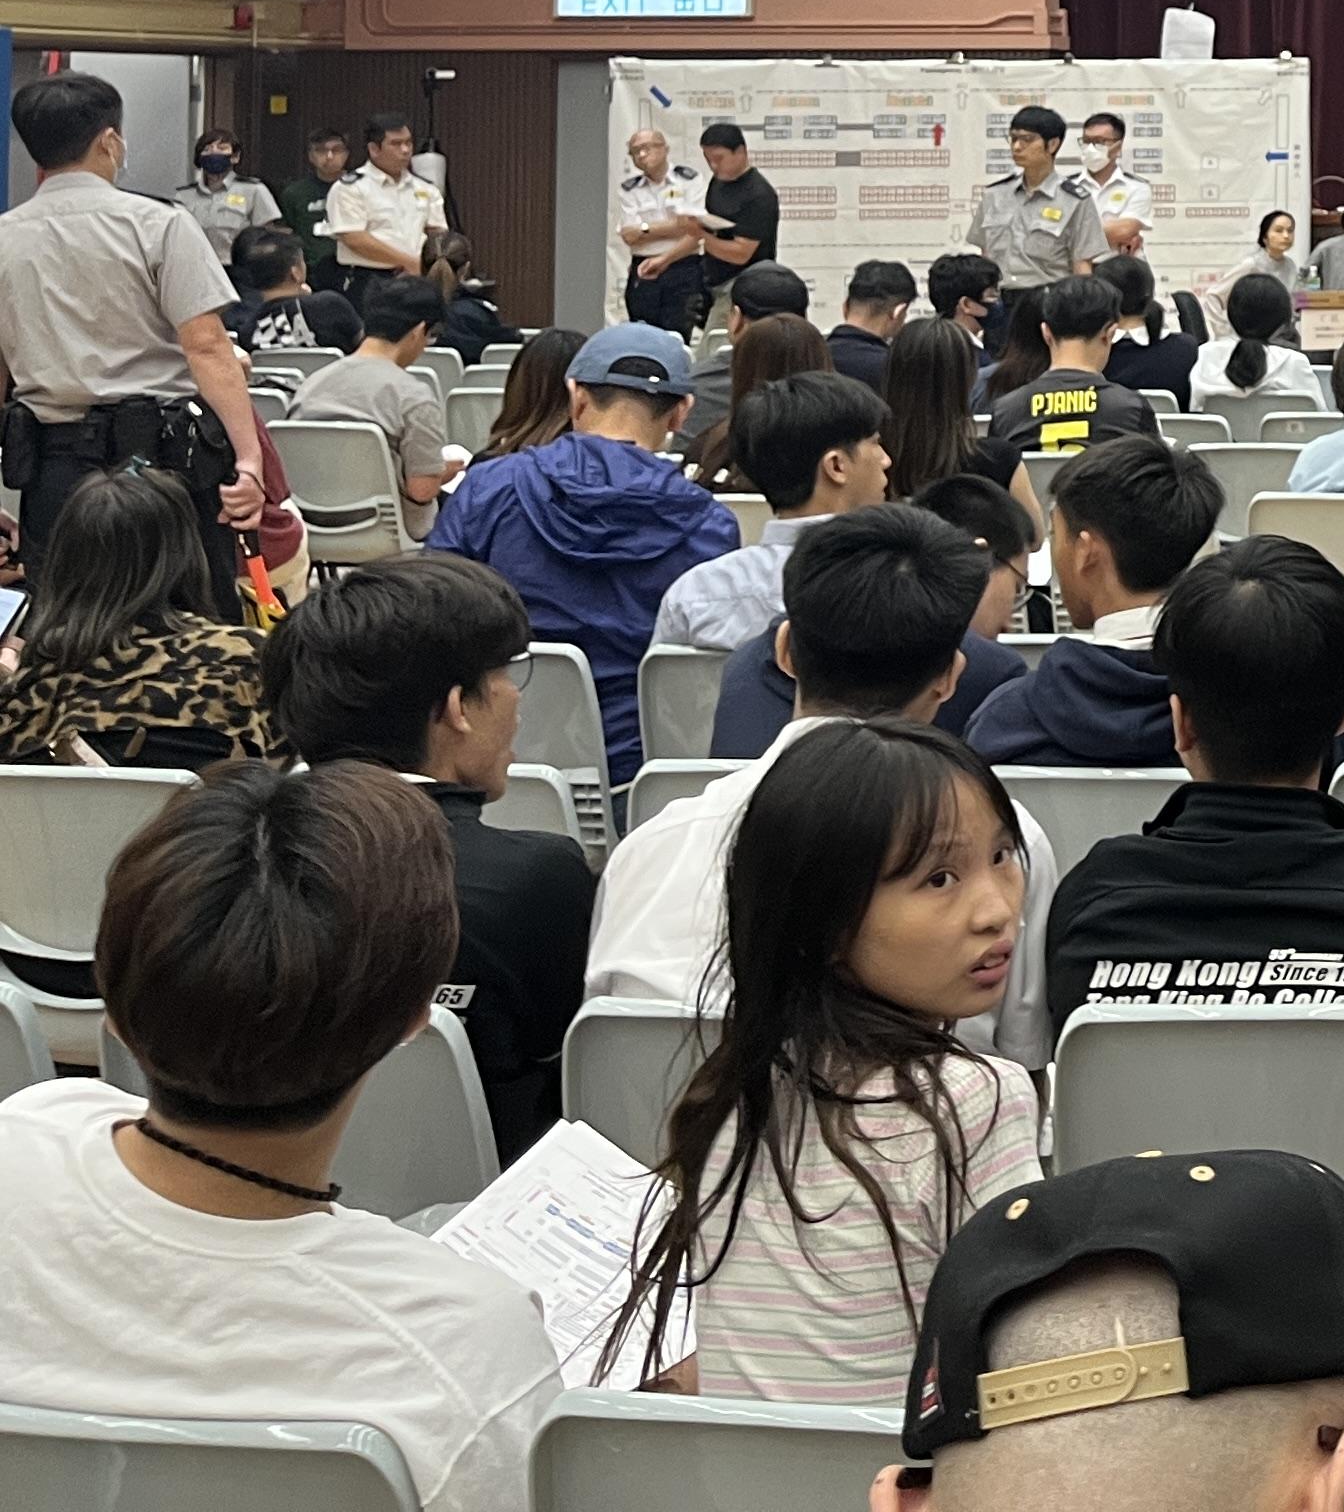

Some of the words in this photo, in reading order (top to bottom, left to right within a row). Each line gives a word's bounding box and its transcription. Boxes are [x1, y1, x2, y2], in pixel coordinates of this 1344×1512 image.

[1030, 385, 1098, 417] PJANIĆ
[1088, 959, 1173, 990] Hong
[1174, 959, 1262, 989] Kong
[1269, 963, 1329, 982] Since
